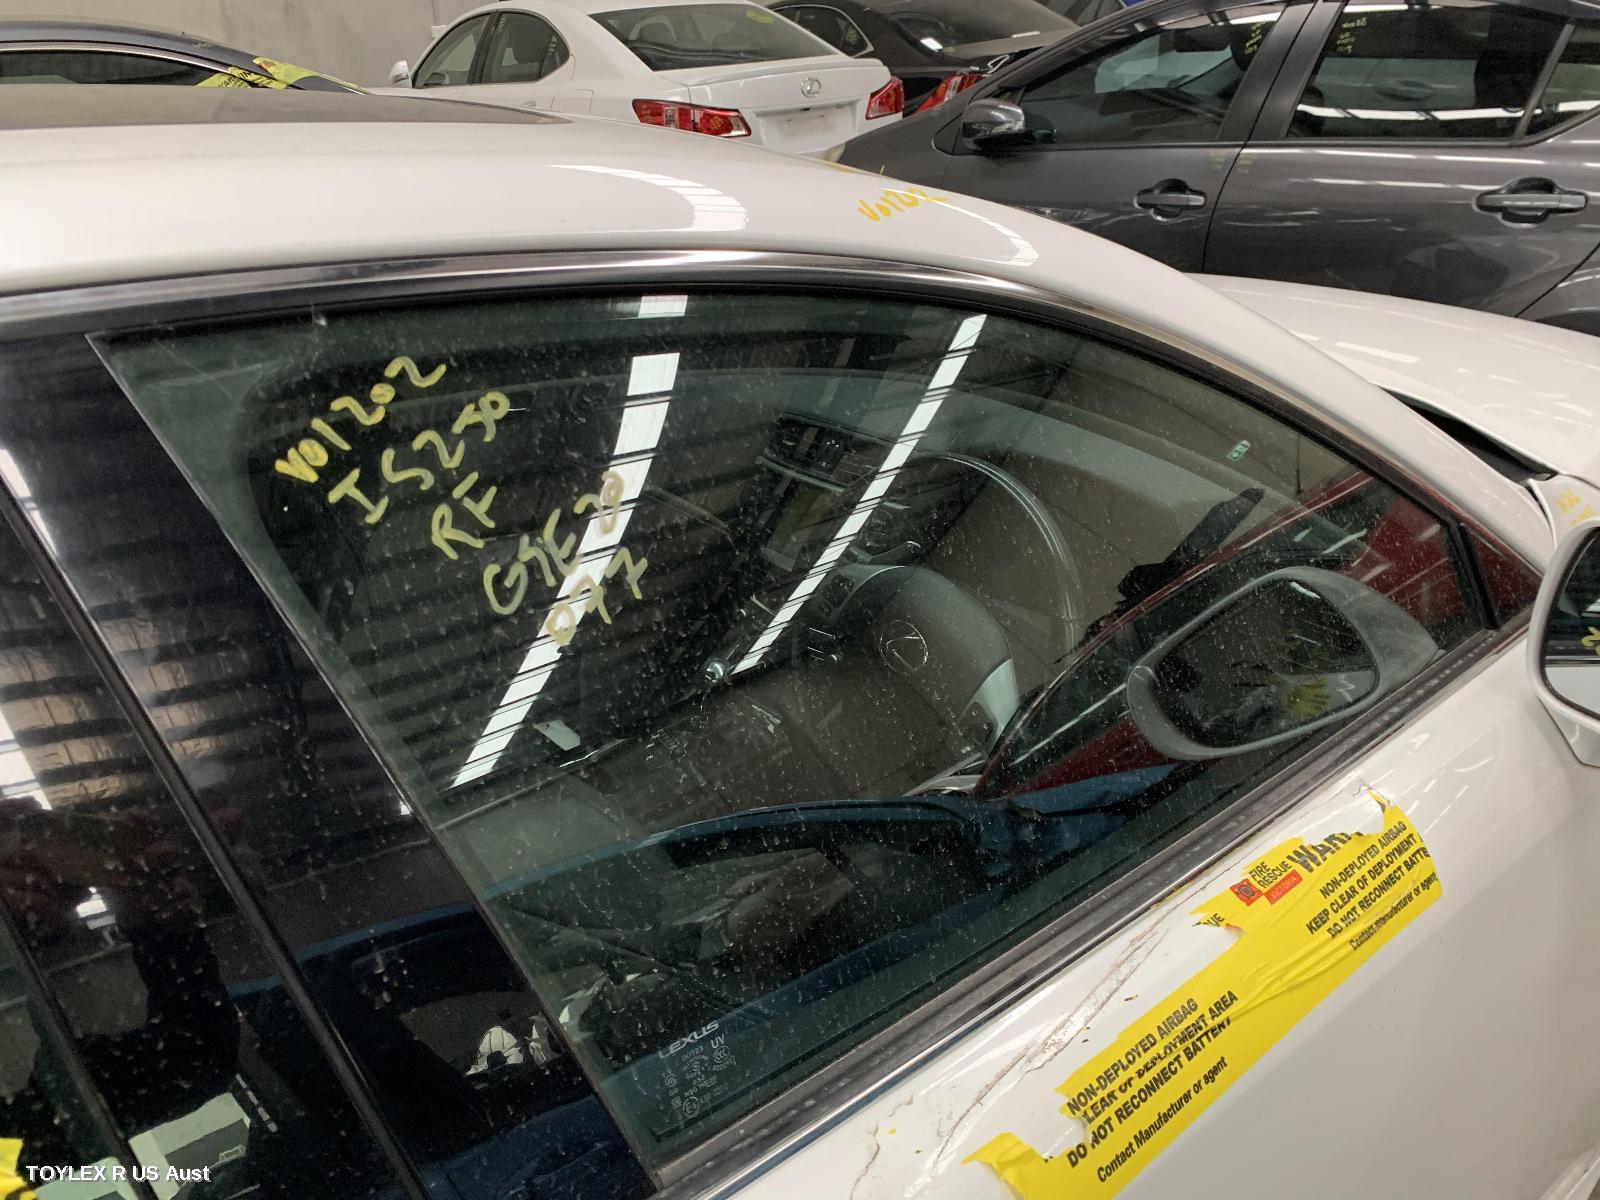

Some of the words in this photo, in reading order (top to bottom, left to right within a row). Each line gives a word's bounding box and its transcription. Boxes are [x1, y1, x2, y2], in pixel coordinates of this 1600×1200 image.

[431, 471, 498, 560] RF
[1249, 861, 1271, 881] FIRE
[1257, 860, 1292, 889] RESCUE
[1305, 908, 1330, 935] KEEP
[1330, 887, 1359, 914] CLEAR
[1356, 874, 1369, 890] OF
[1367, 833, 1417, 881] DEPLOYMENT
[1319, 844, 1380, 899] NON-DEPLOYED
[1377, 821, 1407, 850] AIRBAG
[1326, 922, 1343, 939] DO
[1358, 865, 1405, 912] RECONNECT
[658, 1020, 719, 1059] LEXUS
[711, 1033, 725, 1049] UV
[1066, 1035, 1157, 1115] NON-DEPLOYED
[1156, 998, 1198, 1040] AIRBAG
[1081, 1089, 1119, 1124] LEAR
[1208, 990, 1238, 1020] AREA
[1066, 1142, 1088, 1168] DO
[1114, 1054, 1184, 1125] RECONNECT
[1097, 1142, 1136, 1183] Contact
[1133, 1089, 1193, 1150] Manufacturer
[1193, 1079, 1203, 1094] or
[1203, 1056, 1228, 1087] agent
